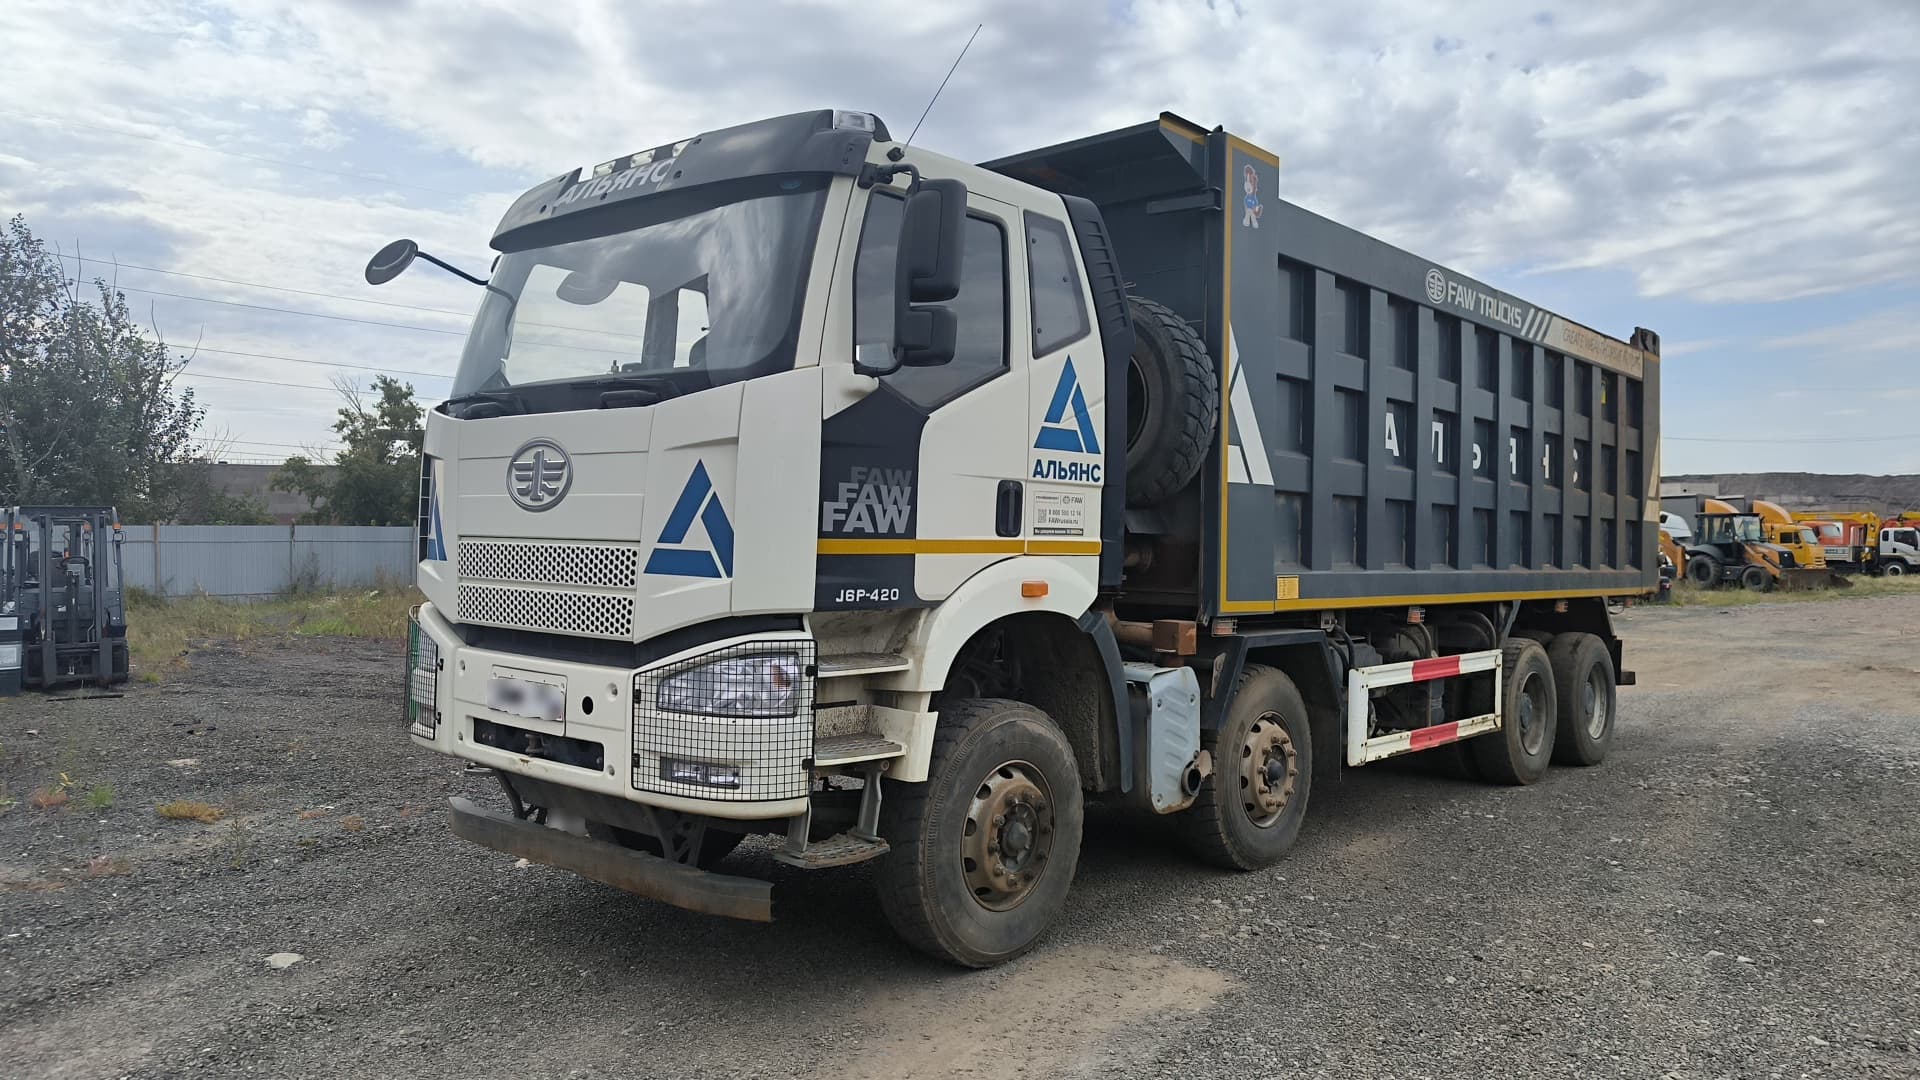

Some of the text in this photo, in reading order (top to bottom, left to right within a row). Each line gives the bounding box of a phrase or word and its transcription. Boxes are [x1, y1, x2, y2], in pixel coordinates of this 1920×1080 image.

[552, 157, 677, 207] АЛЬЯНС
[1447, 281, 1521, 328] FAW TRUCKS
[850, 466, 912, 489] FAW
[1032, 458, 1101, 482] АЛЬЯНС
[838, 482, 912, 510] FAW
[822, 501, 911, 533] FAW
[835, 588, 899, 602] J6P-420
